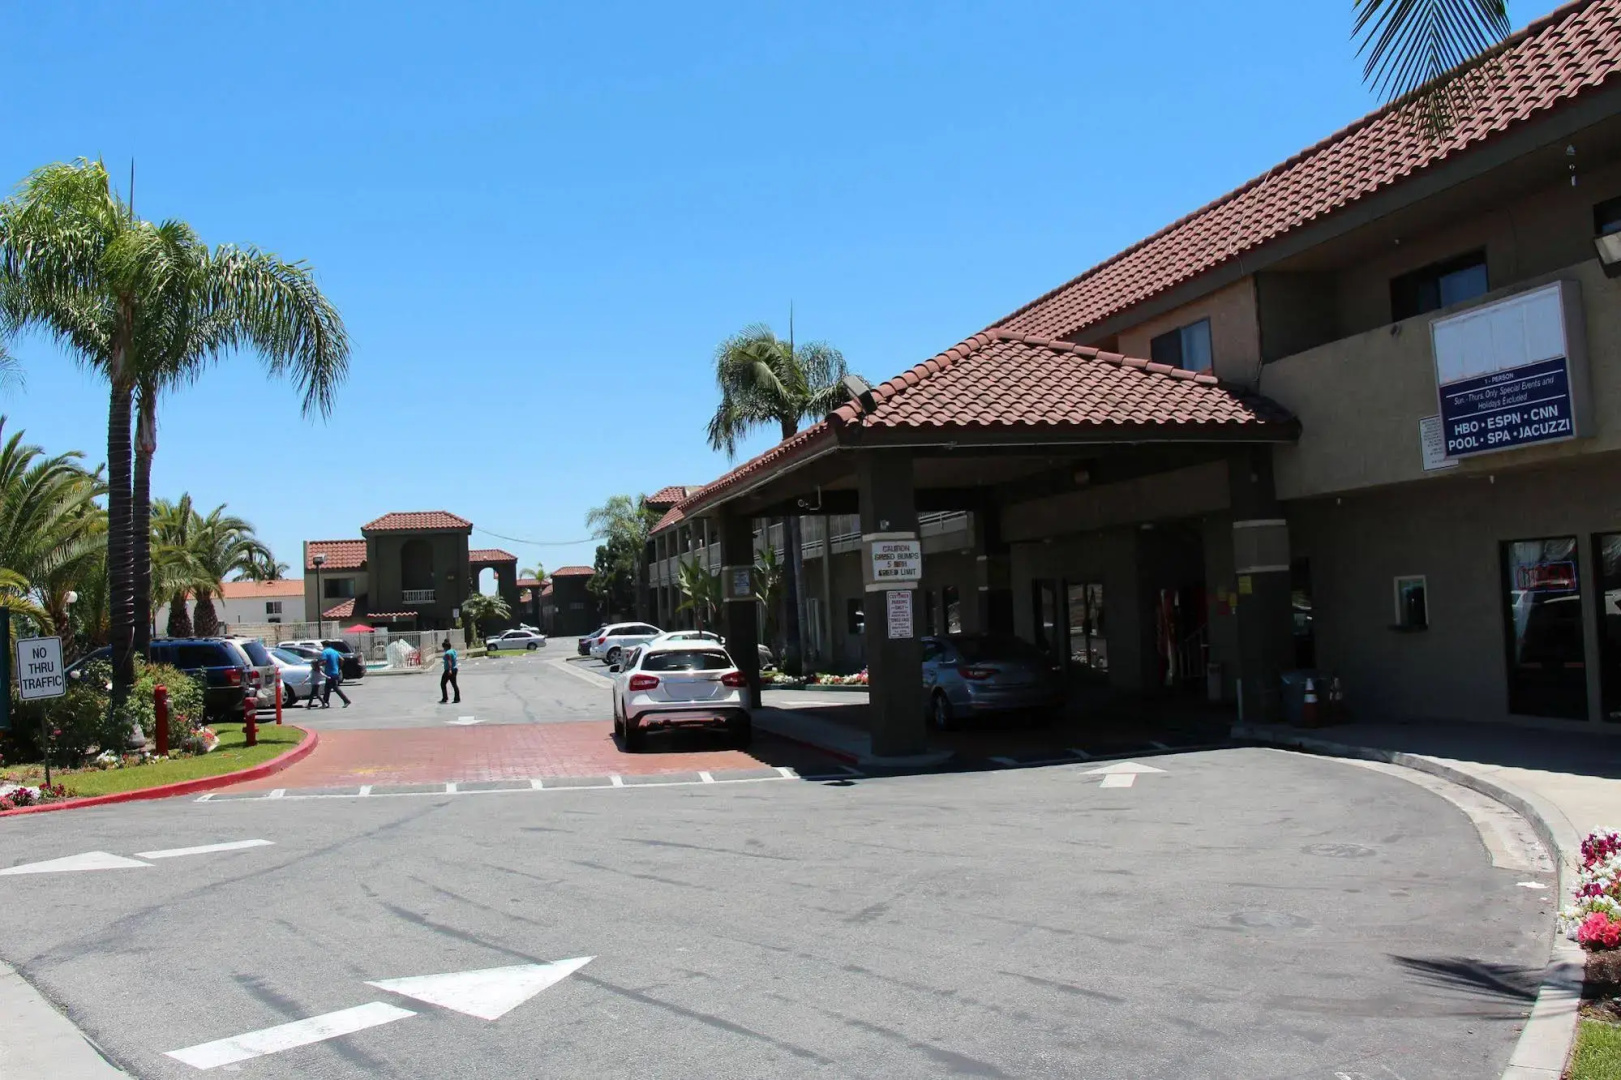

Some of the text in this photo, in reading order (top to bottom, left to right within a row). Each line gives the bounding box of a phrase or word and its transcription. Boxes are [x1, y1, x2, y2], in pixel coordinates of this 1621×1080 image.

[1491, 373, 1514, 383] PERSON
[1500, 384, 1520, 396] Special
[1521, 380, 1541, 390] Events
[1542, 376, 1554, 386] and
[1477, 393, 1528, 410] Holidays Excluded
[1454, 404, 1559, 435] HBO ESPN CNN
[1448, 418, 1570, 451] POOL SPA JACUZZI
[897, 552, 920, 560] BUMPS
[32, 647, 47, 659] NO
[28, 661, 54, 674] THRU
[22, 675, 62, 690] TRAFFIC
